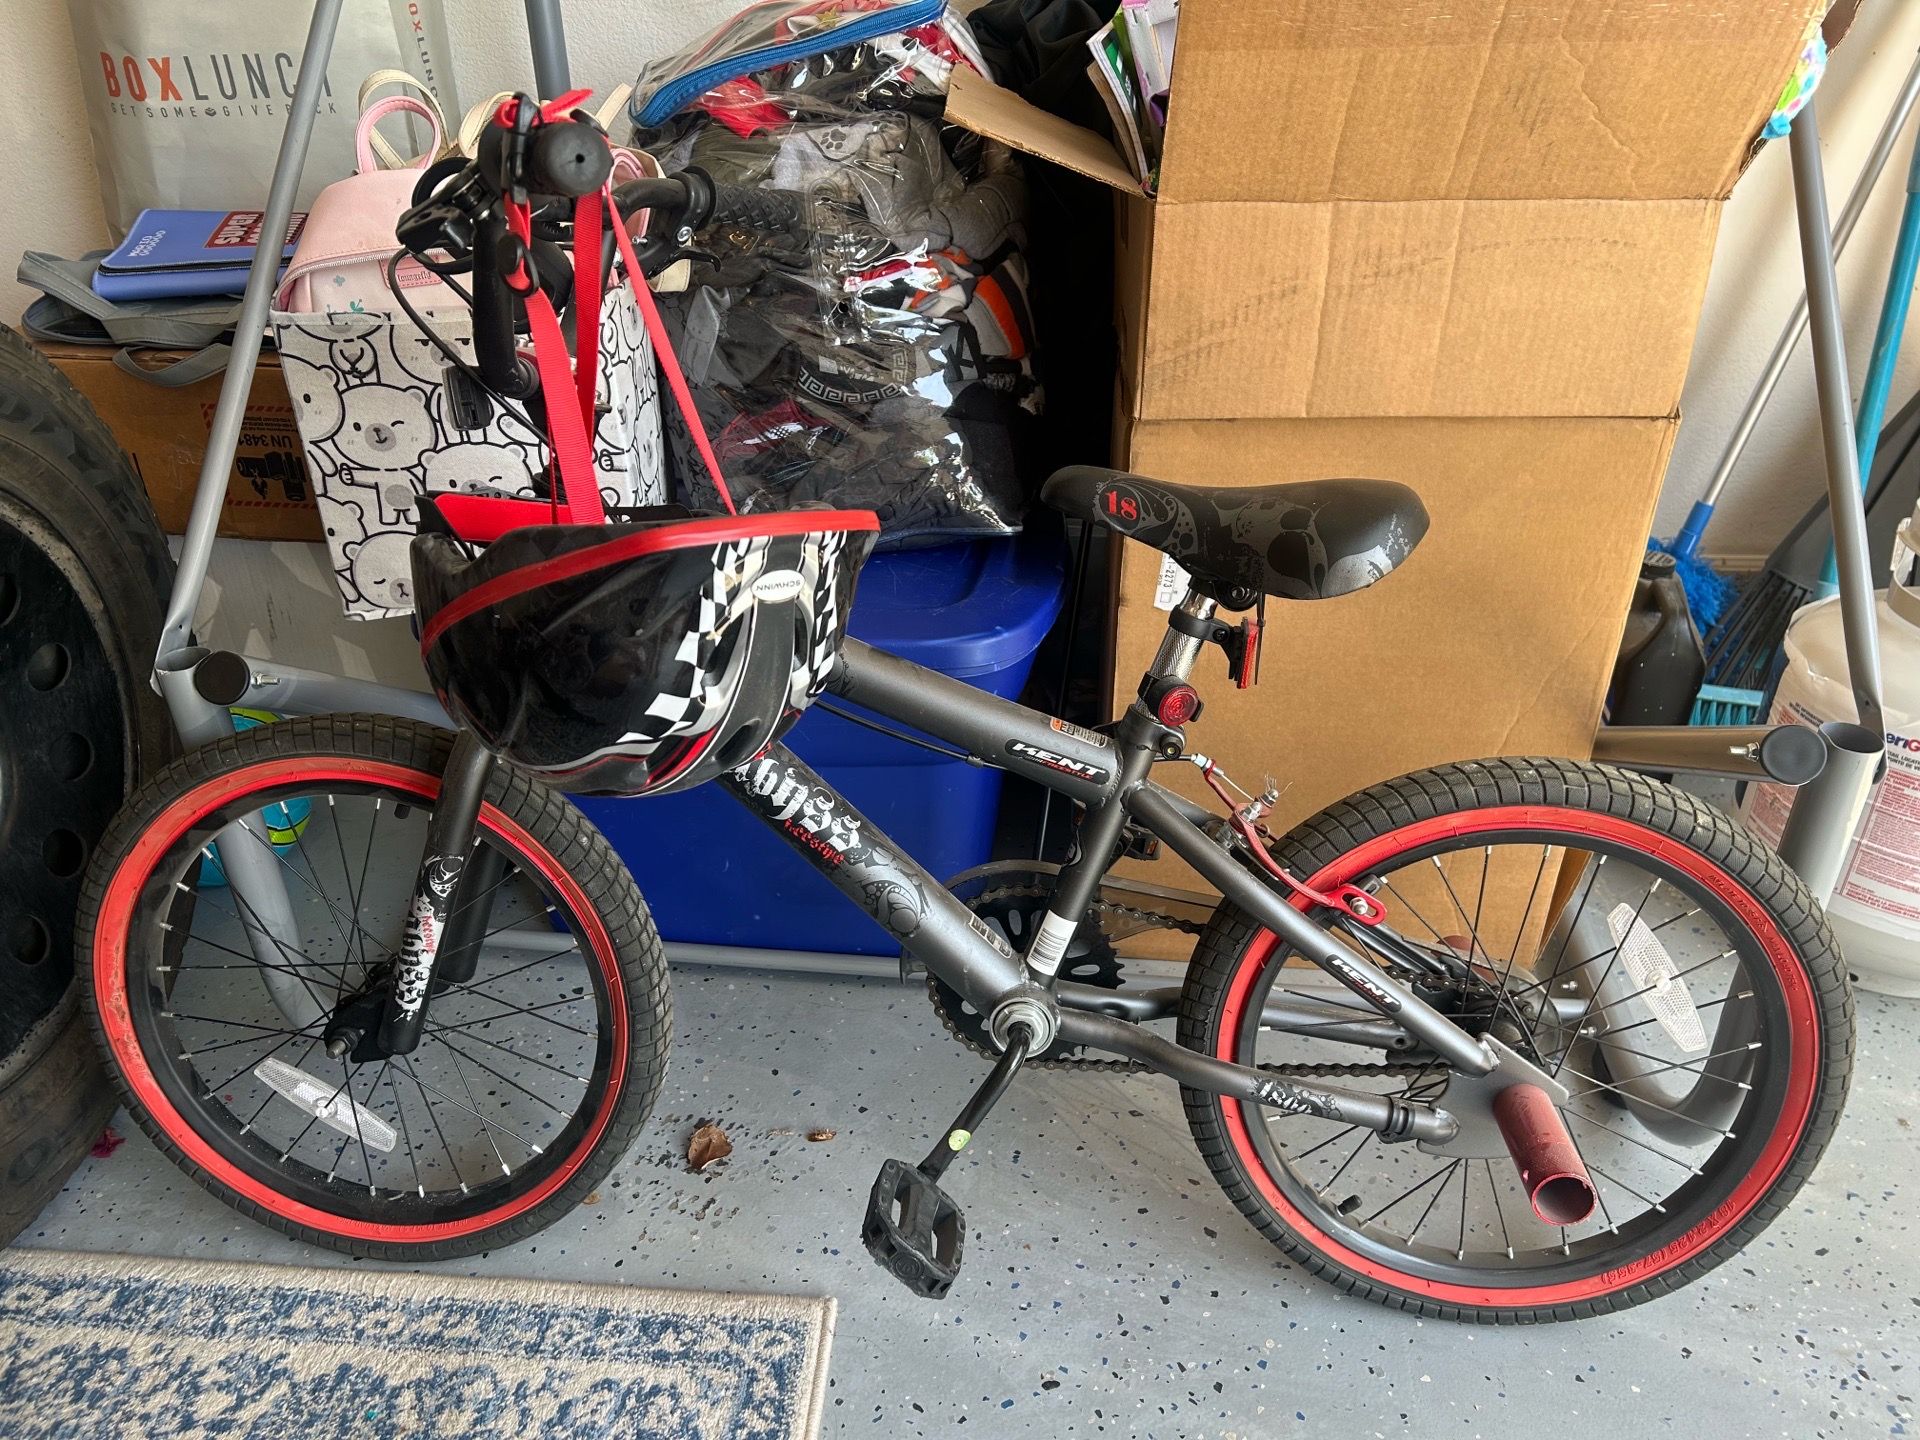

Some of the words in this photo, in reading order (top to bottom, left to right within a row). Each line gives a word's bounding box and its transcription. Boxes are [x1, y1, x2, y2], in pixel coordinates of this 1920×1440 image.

[408, 3, 442, 107] OXLUNC
[100, 52, 332, 101] BOXLUNC
[111, 103, 137, 117] GET
[146, 106, 198, 118] SOME
[222, 104, 274, 117] GIVE
[285, 102, 337, 115] BCK
[214, 213, 257, 245] SUPER
[271, 435, 293, 448] UN
[1106, 490, 1138, 521] 18
[757, 580, 801, 591] SCHWINN
[1012, 742, 1106, 776] KENT
[1331, 959, 1399, 1005] KENT
